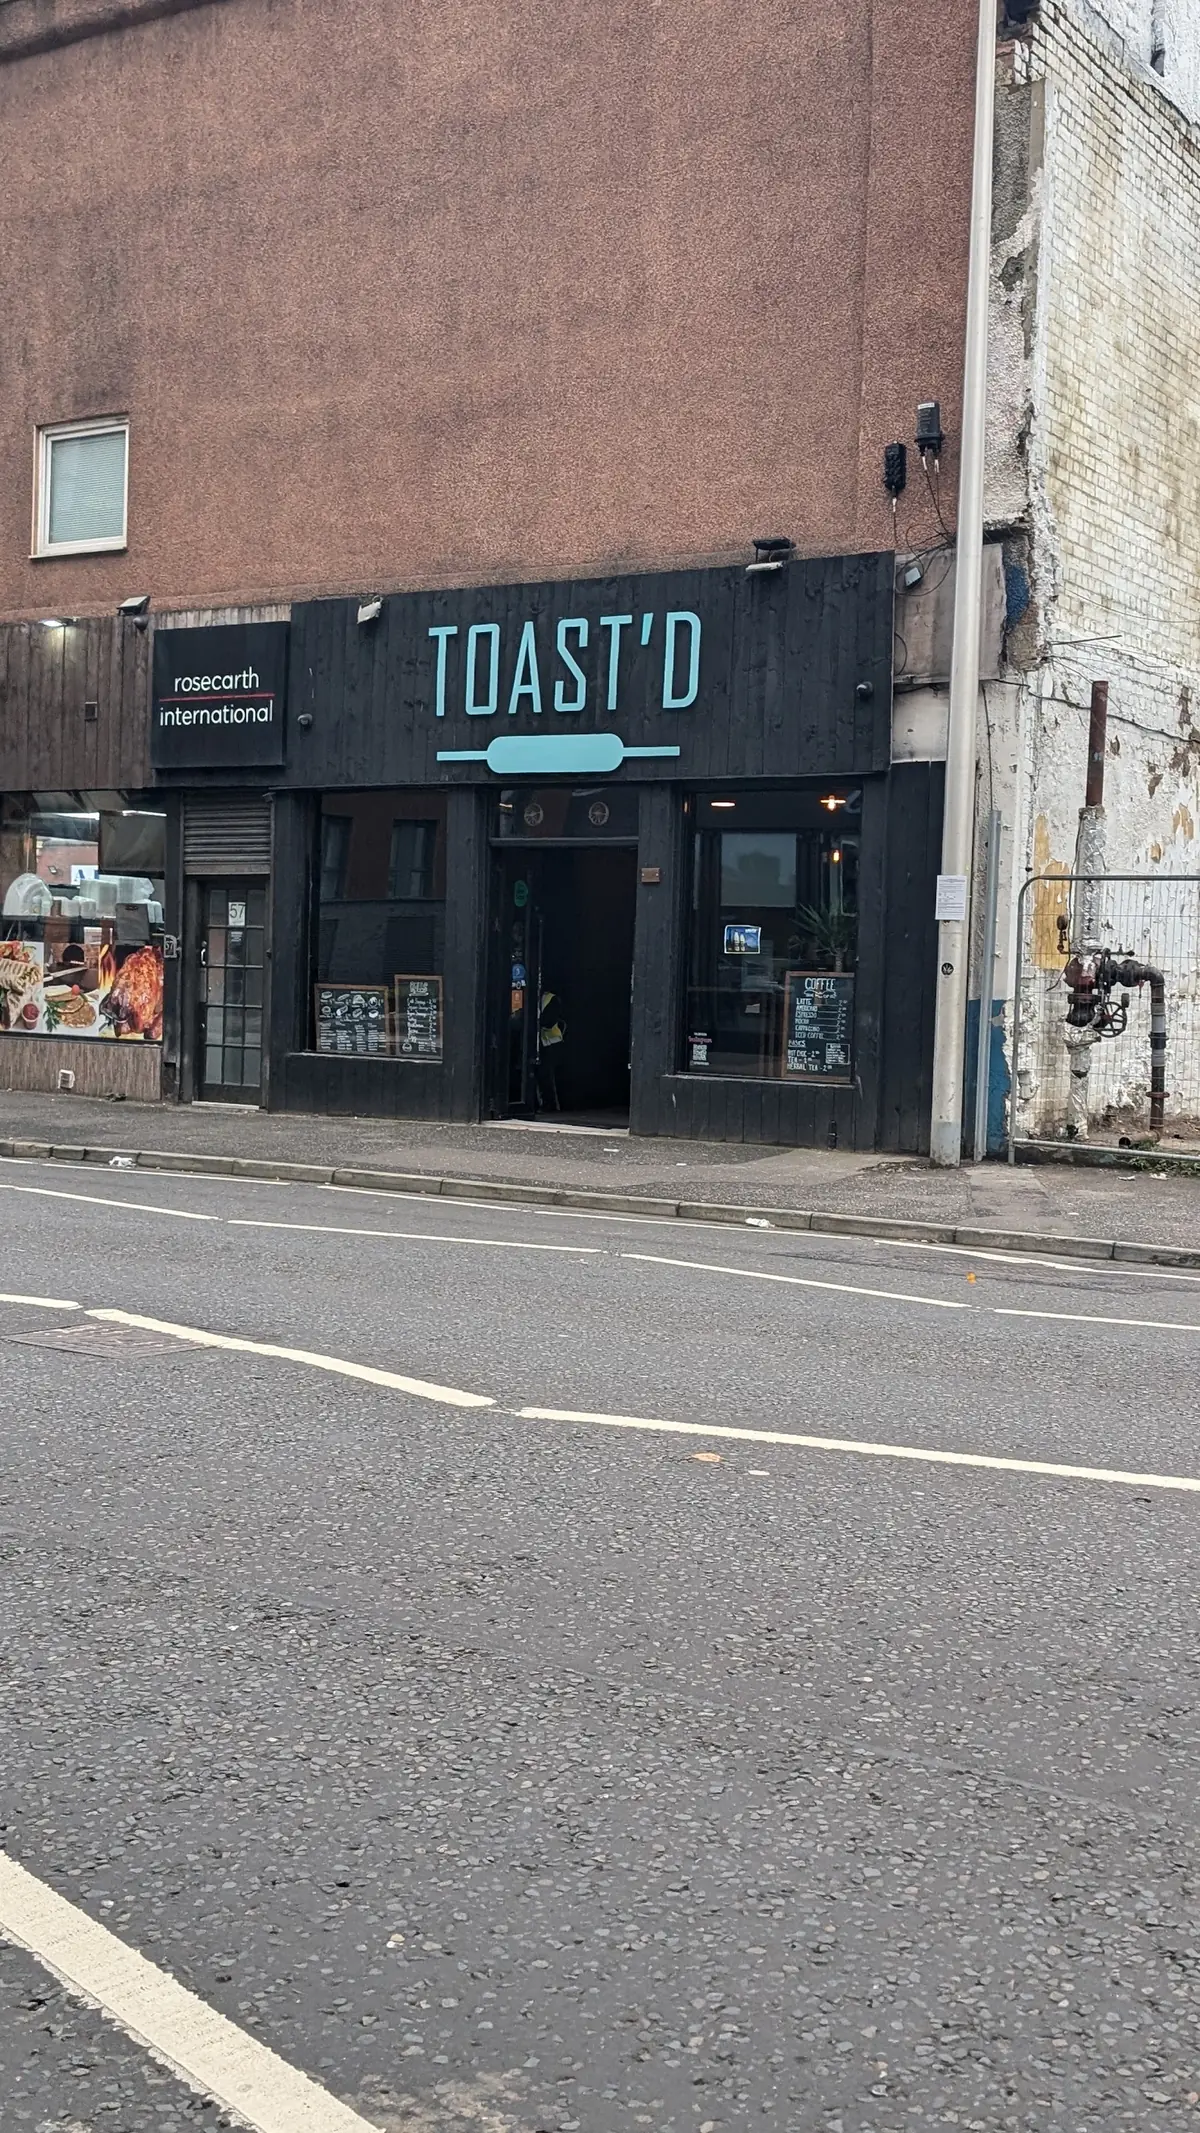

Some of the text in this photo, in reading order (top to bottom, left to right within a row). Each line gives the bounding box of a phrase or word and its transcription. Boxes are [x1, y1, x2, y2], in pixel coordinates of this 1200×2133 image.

[429, 611, 701, 717] TOAST'D
[174, 666, 260, 693] rosecarth
[159, 699, 274, 727] international
[229, 903, 246, 919] 57
[805, 978, 836, 990] COFFEE
